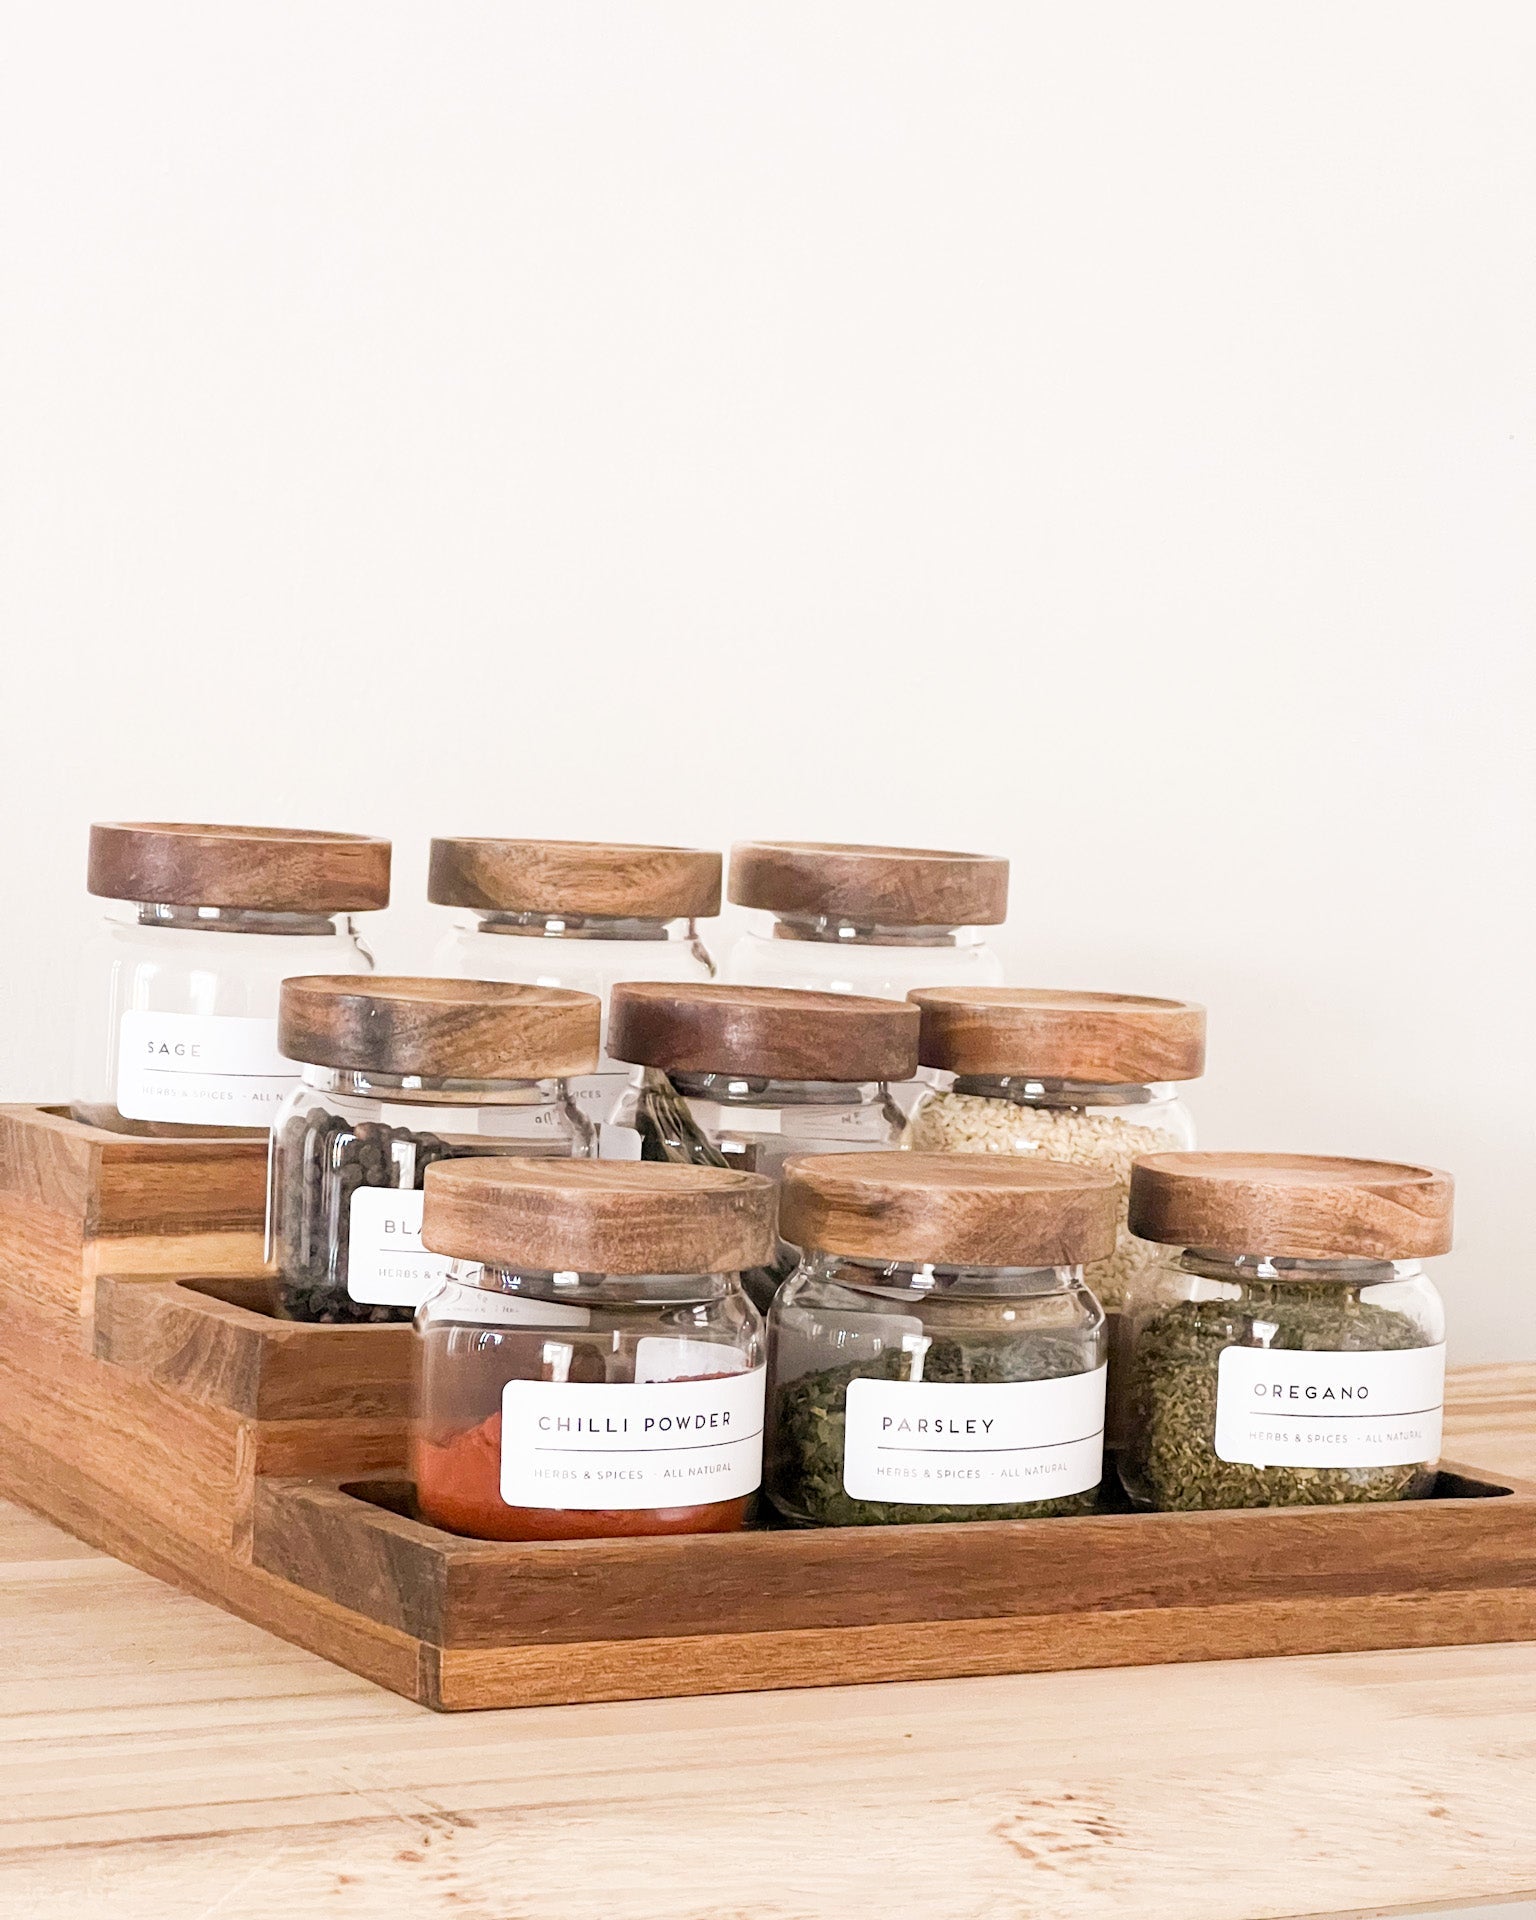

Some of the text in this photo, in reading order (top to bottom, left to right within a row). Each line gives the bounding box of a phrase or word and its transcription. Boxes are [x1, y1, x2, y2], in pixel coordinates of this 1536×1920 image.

[147, 1041, 201, 1057] SAGE
[142, 1085, 177, 1097] HERBS
[194, 1088, 234, 1100] SPICES
[251, 1092, 272, 1101] ALL
[576, 1089, 602, 1099] ICES
[384, 1220, 422, 1235] BL
[378, 1268, 419, 1280] HERBS
[423, 1270, 432, 1280] &
[1254, 1383, 1369, 1400] OREGANO
[538, 1411, 731, 1433] CHILLI POWDER
[882, 1416, 994, 1434] PARSLEY
[1249, 1431, 1289, 1443] HERBS
[1294, 1433, 1302, 1443] &
[1306, 1433, 1348, 1444] SPICES
[1365, 1433, 1383, 1443] ALL
[1386, 1430, 1423, 1442] NATURAL
[534, 1468, 578, 1480] HERBS
[583, 1470, 592, 1480] &
[597, 1470, 644, 1481] SPICES
[663, 1468, 684, 1479] ALL
[688, 1462, 732, 1477] NATURAL
[876, 1466, 918, 1479] HERBS
[923, 1469, 931, 1479] &
[936, 1468, 981, 1480] SPICES
[1000, 1468, 1020, 1478] ALL
[1024, 1462, 1068, 1477] NATURAL
